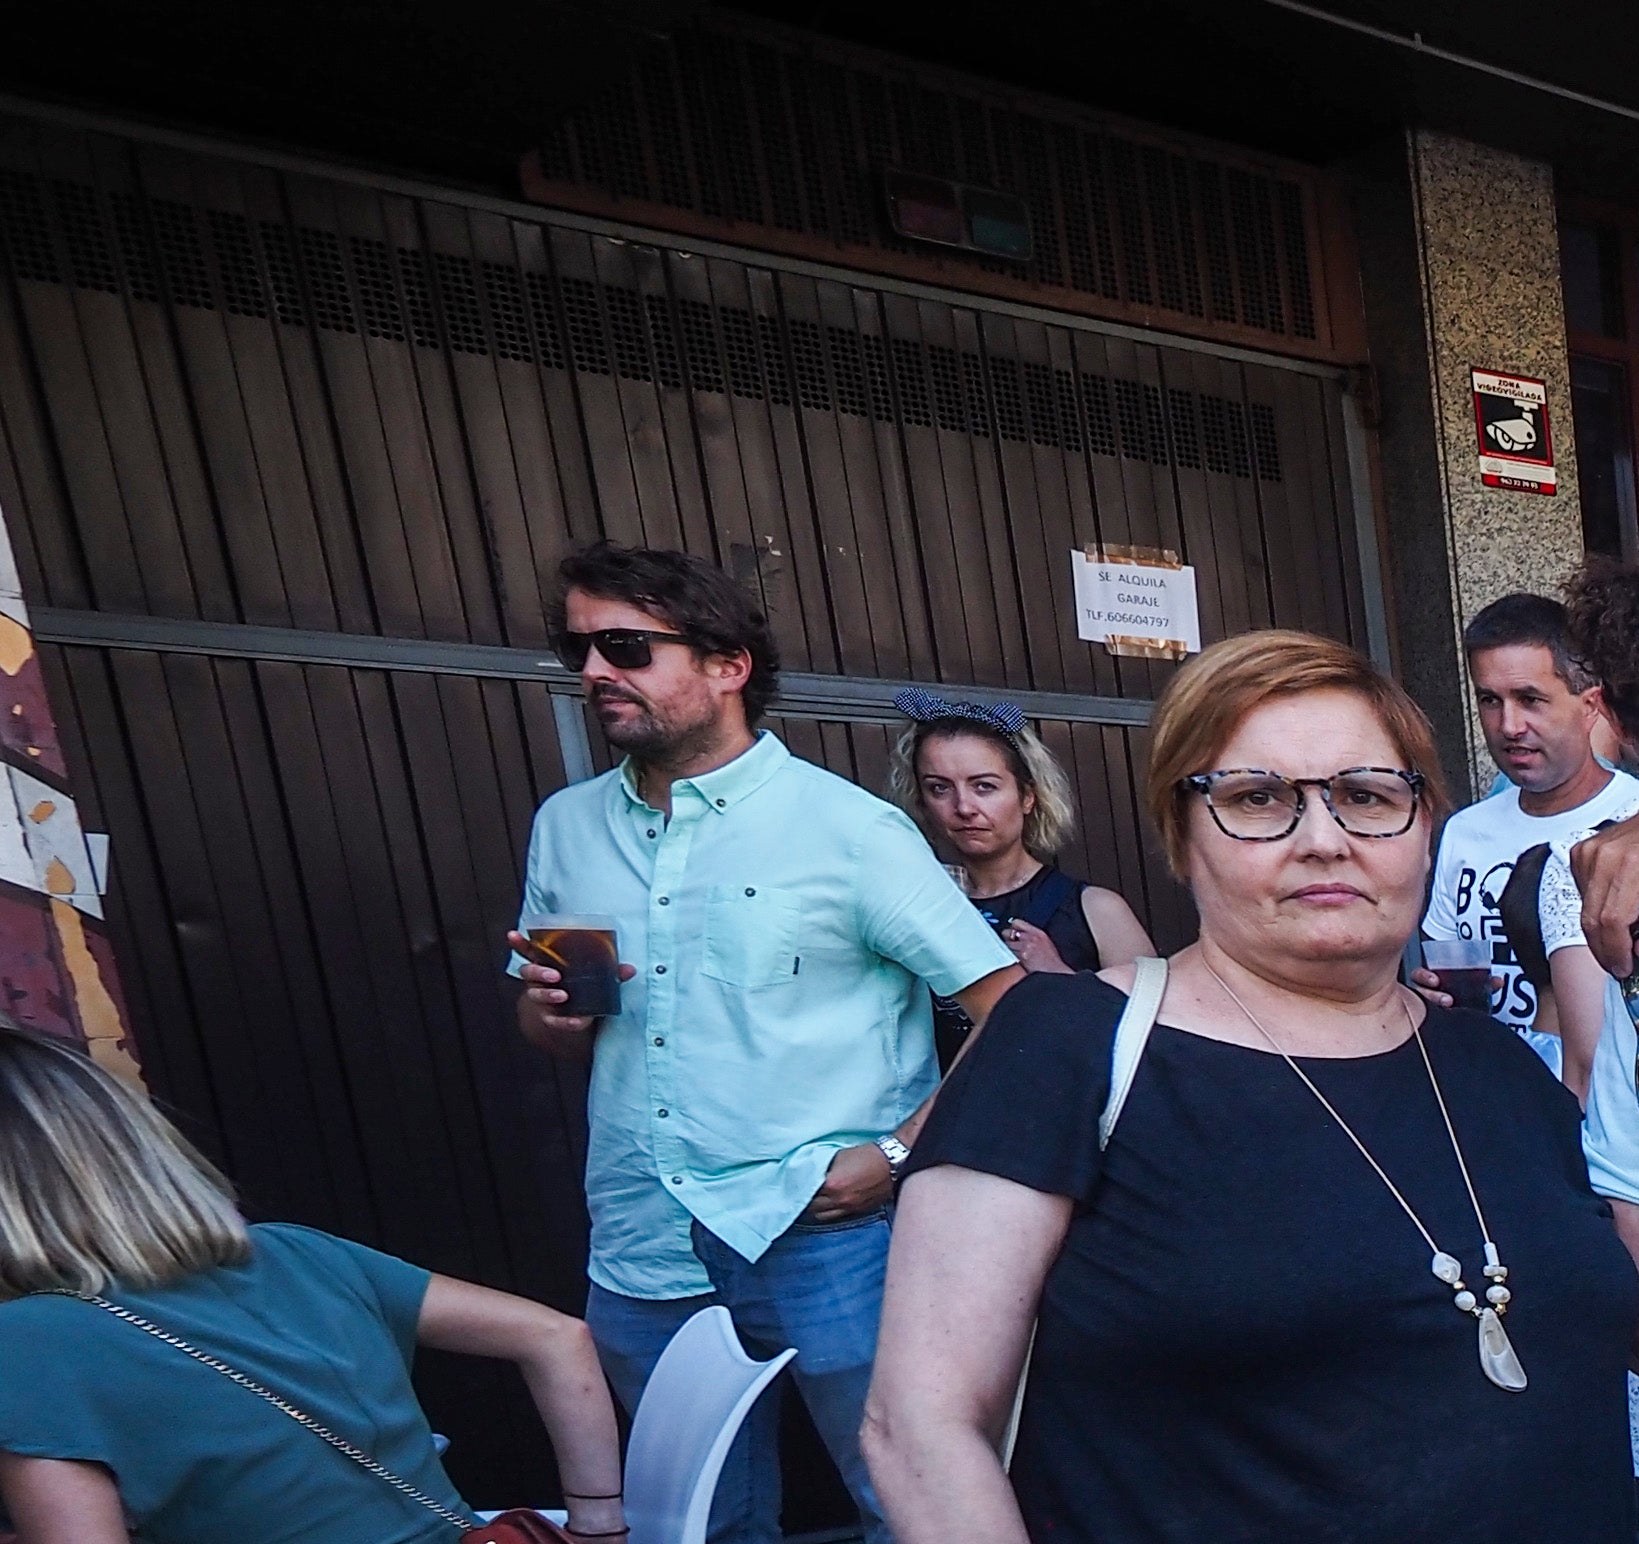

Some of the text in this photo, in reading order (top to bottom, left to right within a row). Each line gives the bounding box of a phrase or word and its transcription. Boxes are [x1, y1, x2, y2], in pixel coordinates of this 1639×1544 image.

[1476, 382, 1542, 401] VIDEOVIGILADA
[1498, 379, 1520, 389] ZONA
[1098, 571, 1167, 588] SE ALQUILA
[1117, 593, 1160, 608] GARAJE
